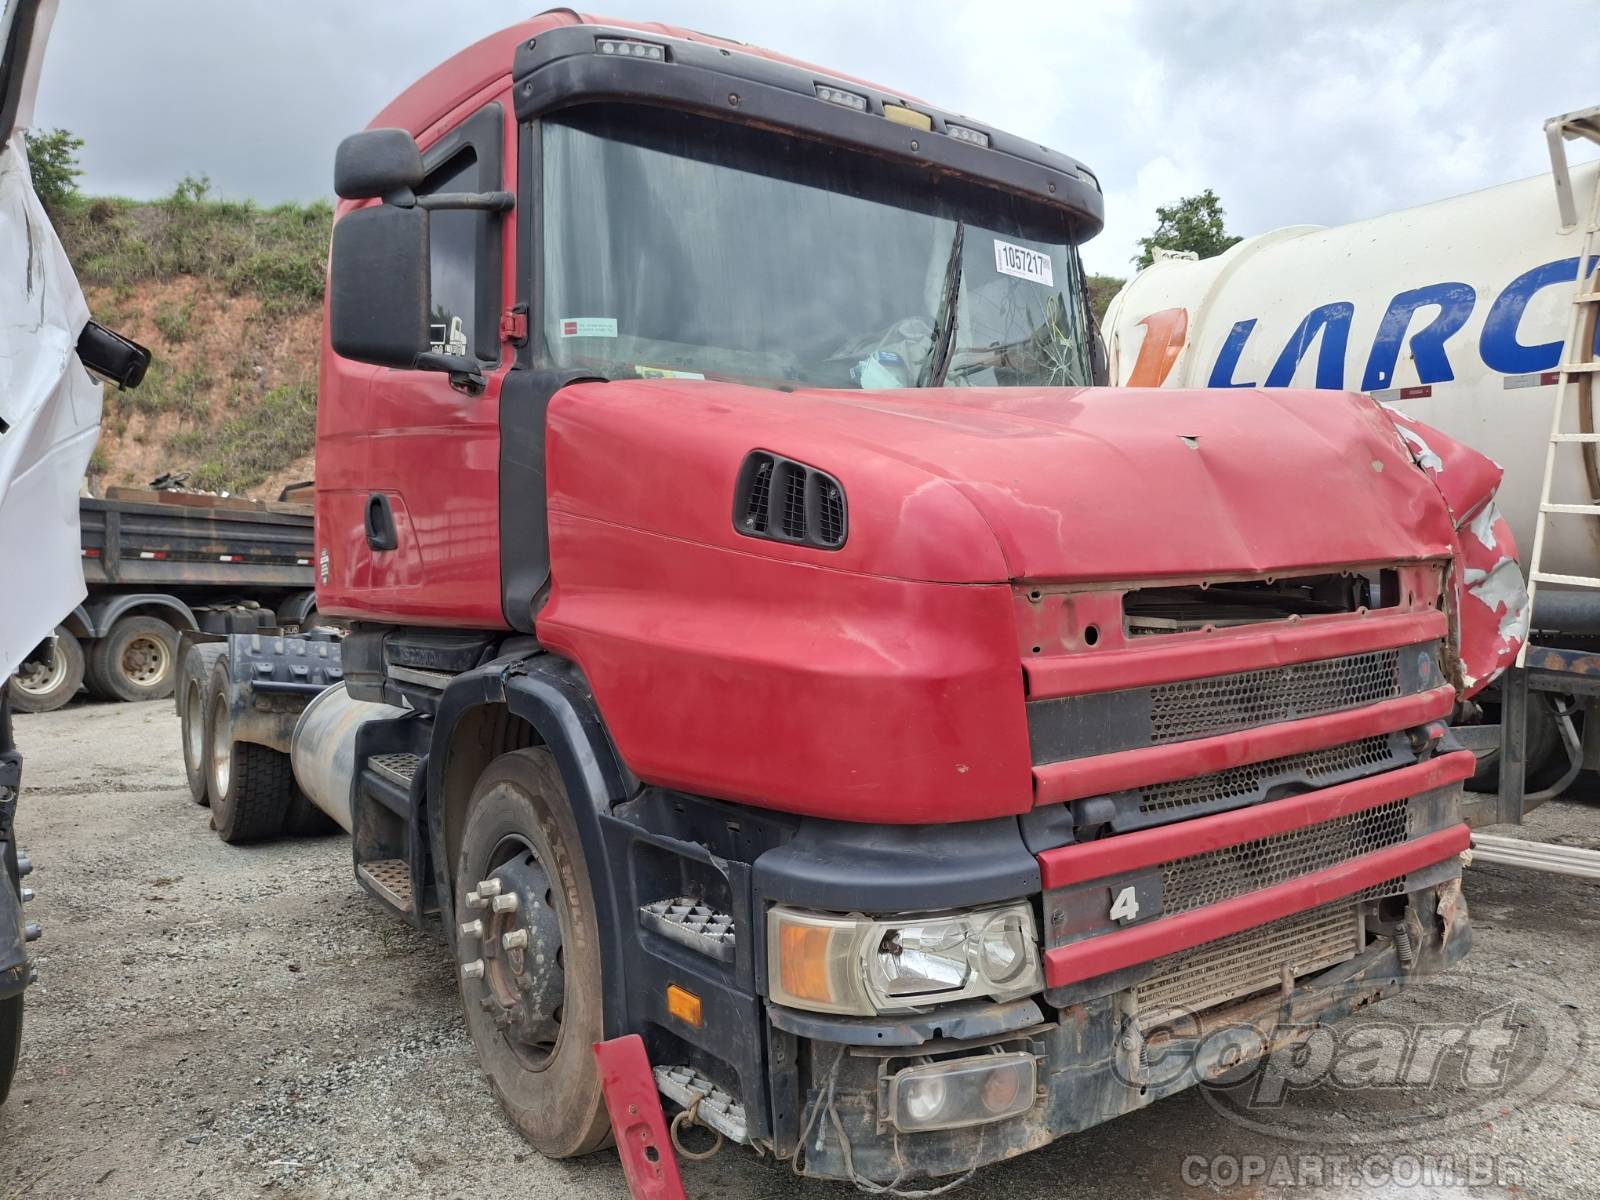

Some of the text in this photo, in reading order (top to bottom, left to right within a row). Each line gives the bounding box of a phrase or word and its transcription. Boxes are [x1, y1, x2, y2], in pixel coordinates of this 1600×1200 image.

[1003, 246, 1043, 276] 1057217
[1207, 255, 1600, 392] LARC
[1109, 886, 1140, 920] 4
